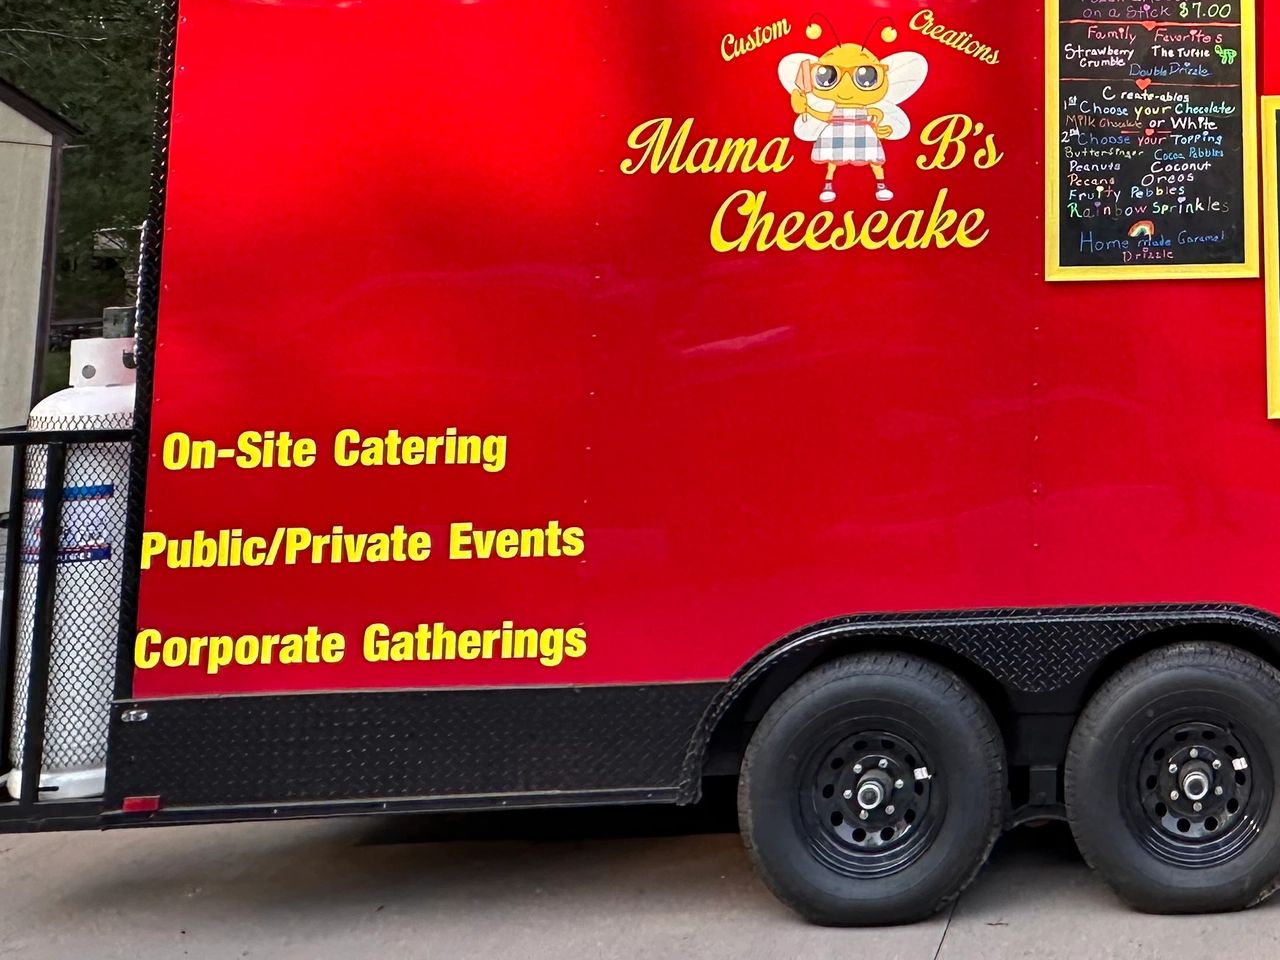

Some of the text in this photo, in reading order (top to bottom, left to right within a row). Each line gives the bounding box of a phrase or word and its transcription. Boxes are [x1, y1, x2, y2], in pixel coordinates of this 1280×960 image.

[1082, 1, 1232, 19] on a Stick $7.00
[720, 8, 1001, 65] Custom Creations
[1087, 25, 1223, 45] Family Favorites
[1064, 43, 1135, 61] Strawberry
[1151, 45, 1210, 58] The Turtle
[1079, 56, 1126, 68] Crumble
[1129, 62, 1167, 77] Double
[1063, 95, 1236, 122] 1st Choose your Chocolate
[1065, 114, 1096, 129] Milk
[1149, 118, 1165, 129] or
[1170, 116, 1218, 131] White
[619, 113, 1003, 175] Mama B's
[1061, 126, 1223, 147] 2nd Choose your Topping
[1065, 146, 1145, 159] Butterfinger
[1069, 160, 1121, 172] Peanuts
[1150, 161, 1212, 173] Coconut
[1067, 173, 1116, 187] Pecans
[1141, 173, 1195, 187] Oreos
[1068, 185, 1186, 202] Fruity Pebbles
[1067, 196, 1230, 220] Rainbow Sprinkles
[710, 187, 991, 253] Cheesecake
[1079, 231, 1129, 253] Home
[1177, 229, 1226, 245] Caramel
[1122, 247, 1174, 262] Drizzle
[162, 427, 508, 473] On-Site Catering
[140, 523, 432, 570] Public/Private
[448, 520, 585, 562] Events
[134, 620, 588, 675] Corporate Gatherings
